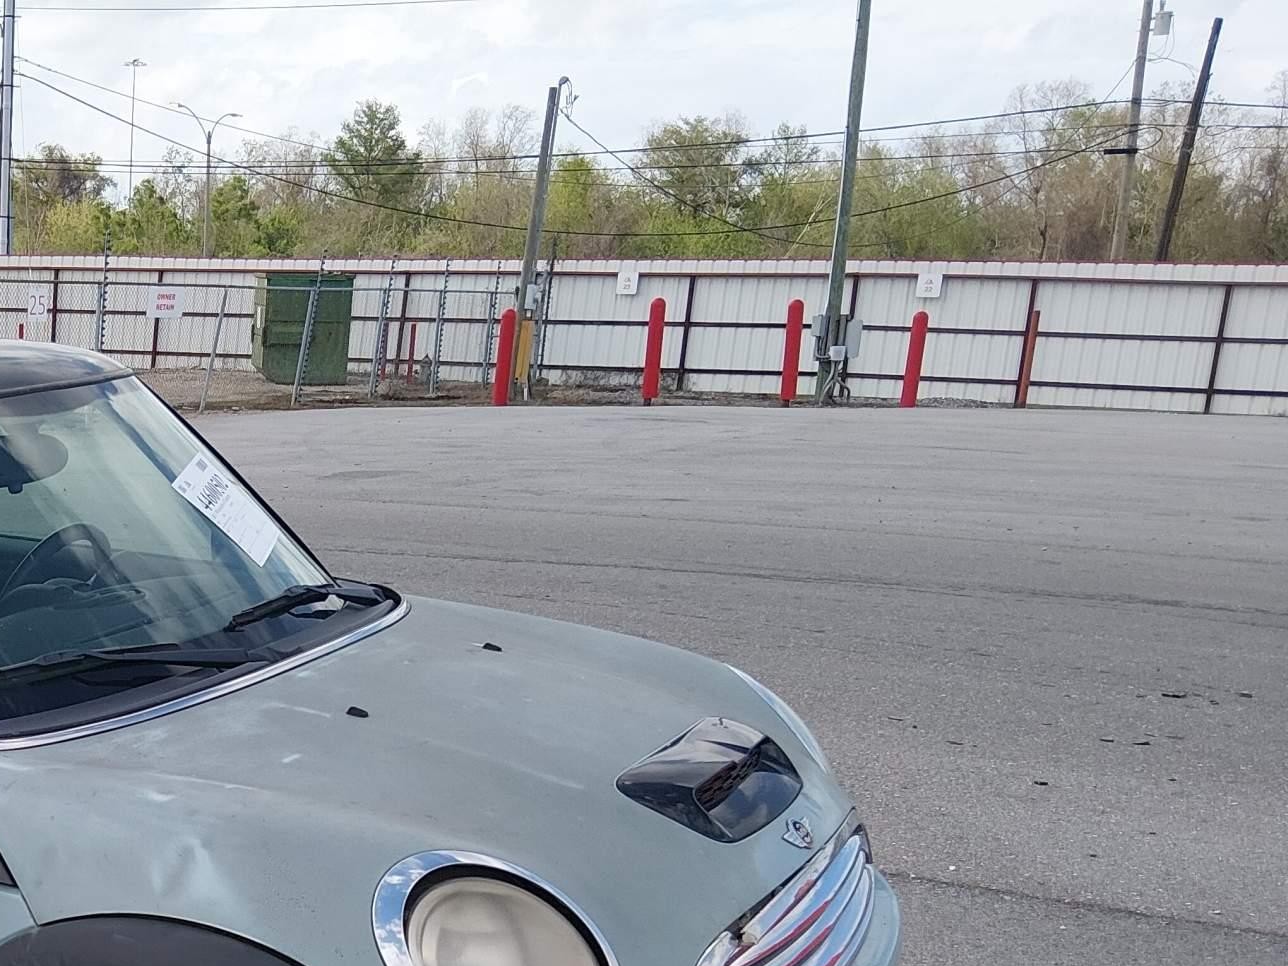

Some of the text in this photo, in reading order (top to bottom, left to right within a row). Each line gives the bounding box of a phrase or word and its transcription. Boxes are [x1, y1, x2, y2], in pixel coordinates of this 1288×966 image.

[29, 295, 45, 315] 25
[156, 293, 176, 301] OWNER
[196, 473, 229, 512] 44600502
